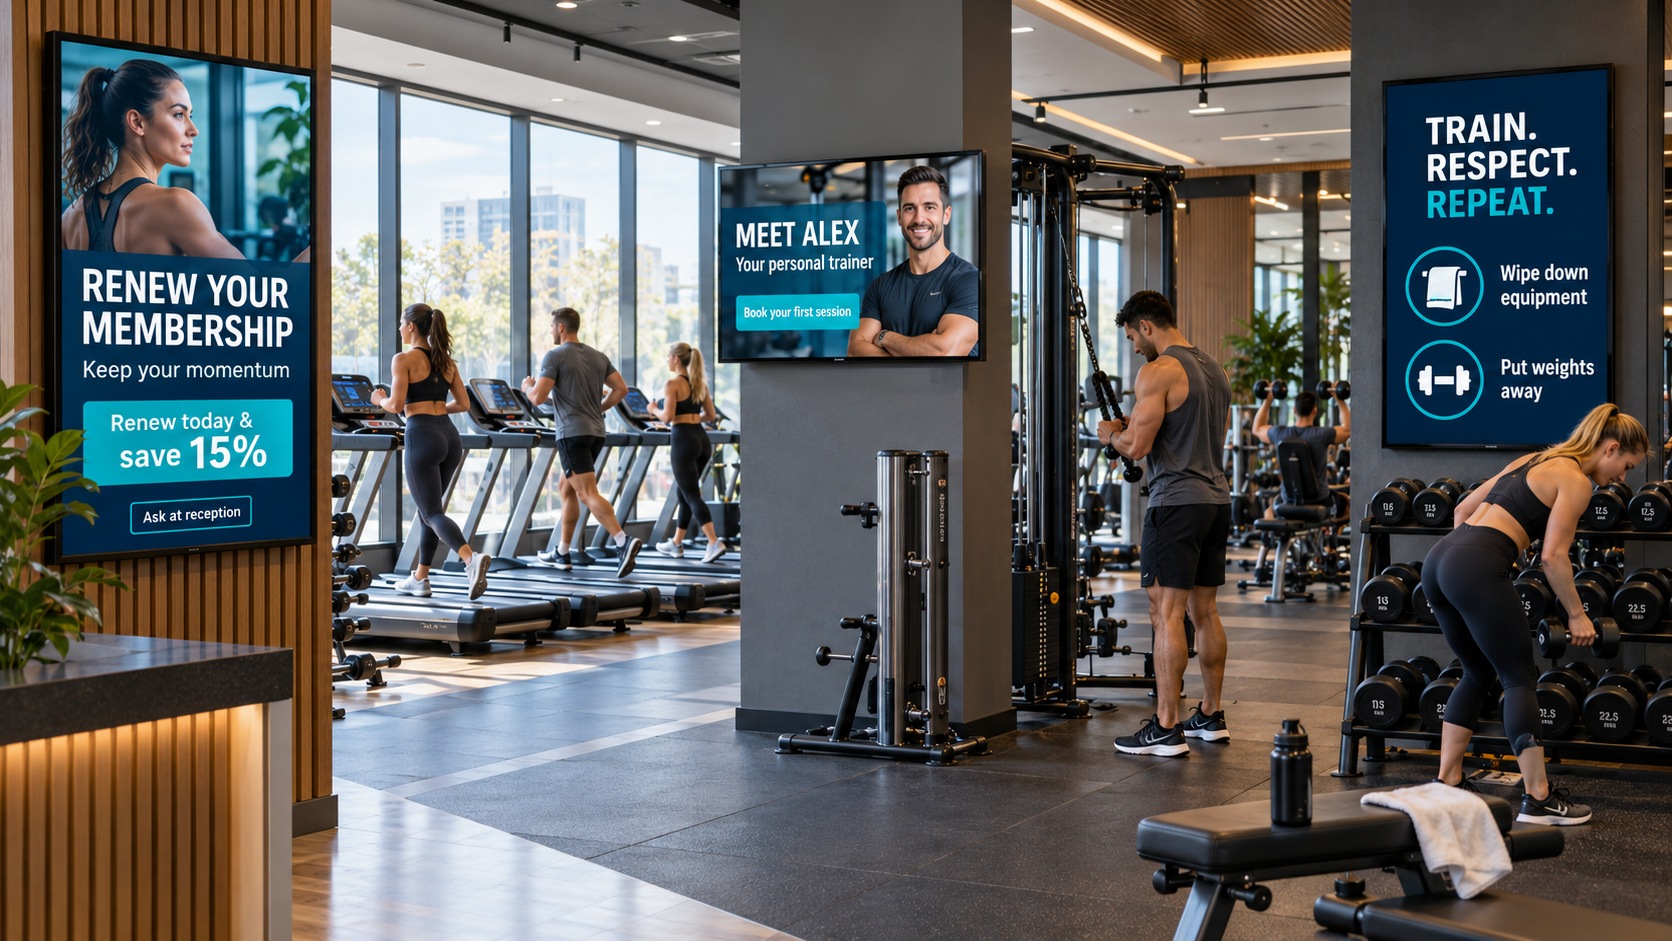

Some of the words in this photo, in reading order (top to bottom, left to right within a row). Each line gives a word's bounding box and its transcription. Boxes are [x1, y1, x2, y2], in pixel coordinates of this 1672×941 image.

[1425, 111, 1537, 145] TRAIN.
[1427, 147, 1578, 182] RESPECT.
[1427, 186, 1554, 218] REPEAT.
[736, 221, 796, 248] MEET
[802, 219, 860, 246] ALEX
[735, 256, 766, 272] Your
[768, 254, 825, 275] personal
[828, 254, 875, 271] trainer
[1500, 264, 1540, 285] Wipe
[1544, 264, 1589, 281] down
[82, 267, 198, 305] RENEW
[207, 274, 289, 309] YOUR
[1500, 289, 1588, 310] equipment
[743, 306, 768, 319] Book
[769, 309, 792, 321] your
[793, 306, 814, 318] first
[815, 306, 852, 318] session
[82, 311, 294, 348] MEMBERSHIP
[83, 360, 132, 382] Keep
[138, 364, 181, 383] your
[186, 362, 290, 379] momentum
[1501, 358, 1528, 376] Put
[1531, 357, 1595, 380] weights
[1500, 386, 1543, 403] away
[111, 414, 177, 432] Renew
[181, 412, 235, 433] today
[240, 412, 253, 429] &
[120, 448, 181, 469] save
[189, 434, 267, 470] 15%
[143, 509, 167, 524] Ask
[169, 510, 182, 522] at
[185, 506, 241, 522] reception
